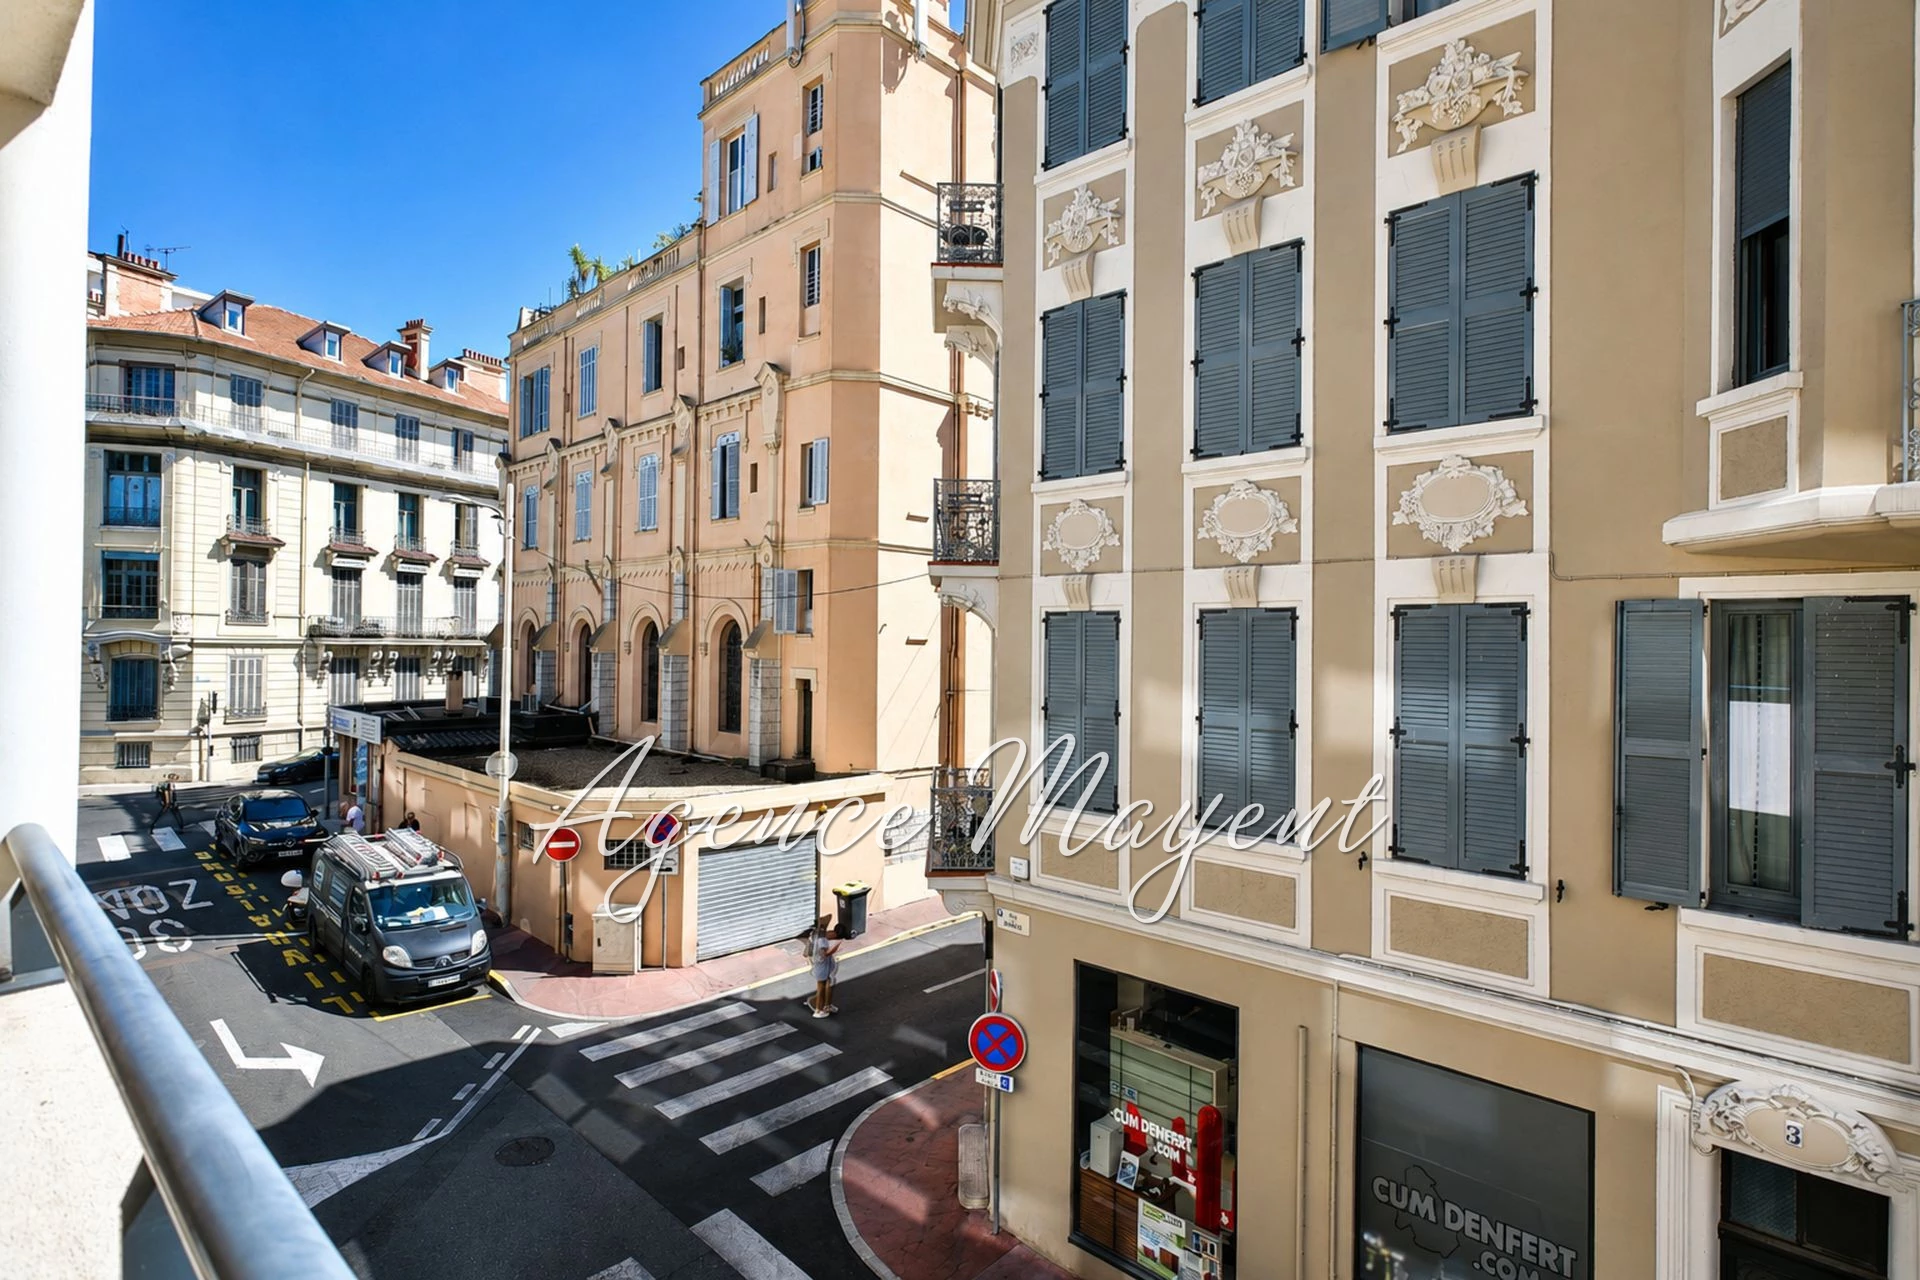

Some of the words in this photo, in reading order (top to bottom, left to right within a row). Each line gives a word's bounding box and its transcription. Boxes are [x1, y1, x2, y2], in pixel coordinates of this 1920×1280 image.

[1786, 1125, 1800, 1145] 3
[1373, 1176, 1437, 1223] CUM
[1444, 1201, 1577, 1278] DENFERT
